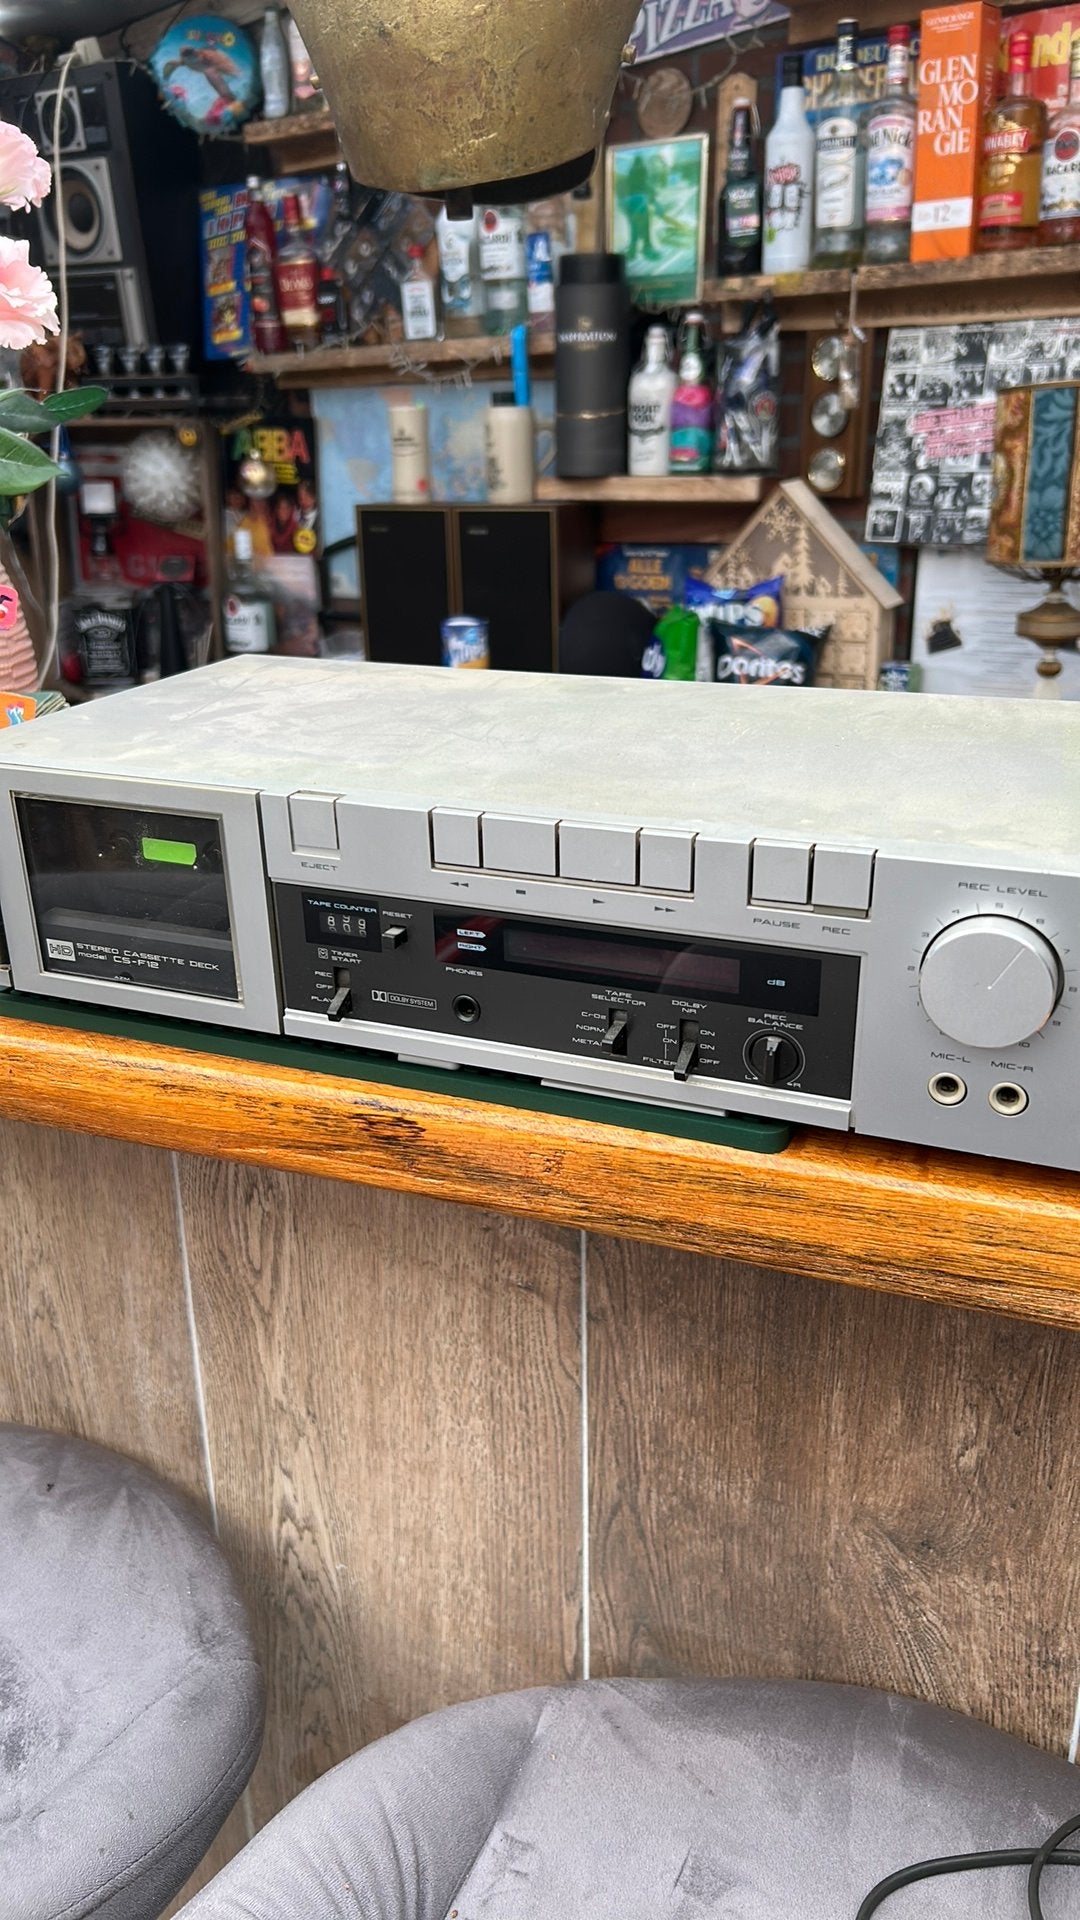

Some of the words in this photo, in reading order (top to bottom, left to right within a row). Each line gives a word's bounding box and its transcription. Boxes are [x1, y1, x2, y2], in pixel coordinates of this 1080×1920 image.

[920, 54, 978, 85] GLEN
[938, 80, 979, 107] MO
[917, 106, 963, 136] RAN
[933, 127, 971, 157] GIE
[301, 861, 338, 871] EJECT
[958, 881, 991, 892] REC
[996, 886, 1049, 898] LEVEL
[307, 899, 332, 908] TAPE
[333, 903, 378, 914] COUNTER
[382, 910, 414, 919] RESET
[752, 917, 801, 930] PAUSE
[821, 925, 851, 936] REC
[458, 930, 481, 938] LEFT
[48, 942, 74, 958] HD
[458, 943, 482, 951] RIGHT
[76, 942, 119, 955] STEREO
[123, 949, 185, 966] CASSETTE
[189, 960, 220, 971] DECK
[331, 949, 359, 958] TIMER
[77, 951, 107, 960] model
[113, 955, 160, 969] CS-F12
[331, 956, 362, 964] START
[314, 970, 333, 978] REC
[445, 966, 484, 977] PHONES
[767, 979, 786, 987] dB
[311, 995, 334, 1003] PLAY
[605, 989, 632, 999] TAPE
[390, 994, 409, 1003] DOLBY
[409, 997, 435, 1008] SYSTEM
[591, 993, 647, 1007] SELECTOR
[671, 999, 708, 1010] DOLBY
[681, 1007, 697, 1015] NR
[764, 1013, 787, 1021] REC
[656, 1022, 677, 1030] OFF
[747, 1017, 804, 1031] BALANCE
[700, 1029, 716, 1037] ON
[662, 1037, 678, 1045] ON
[700, 1043, 715, 1051] ON
[642, 1056, 678, 1066] FILTER
[930, 1051, 971, 1063] MIC-L
[990, 1061, 1034, 1073] MIC-R
